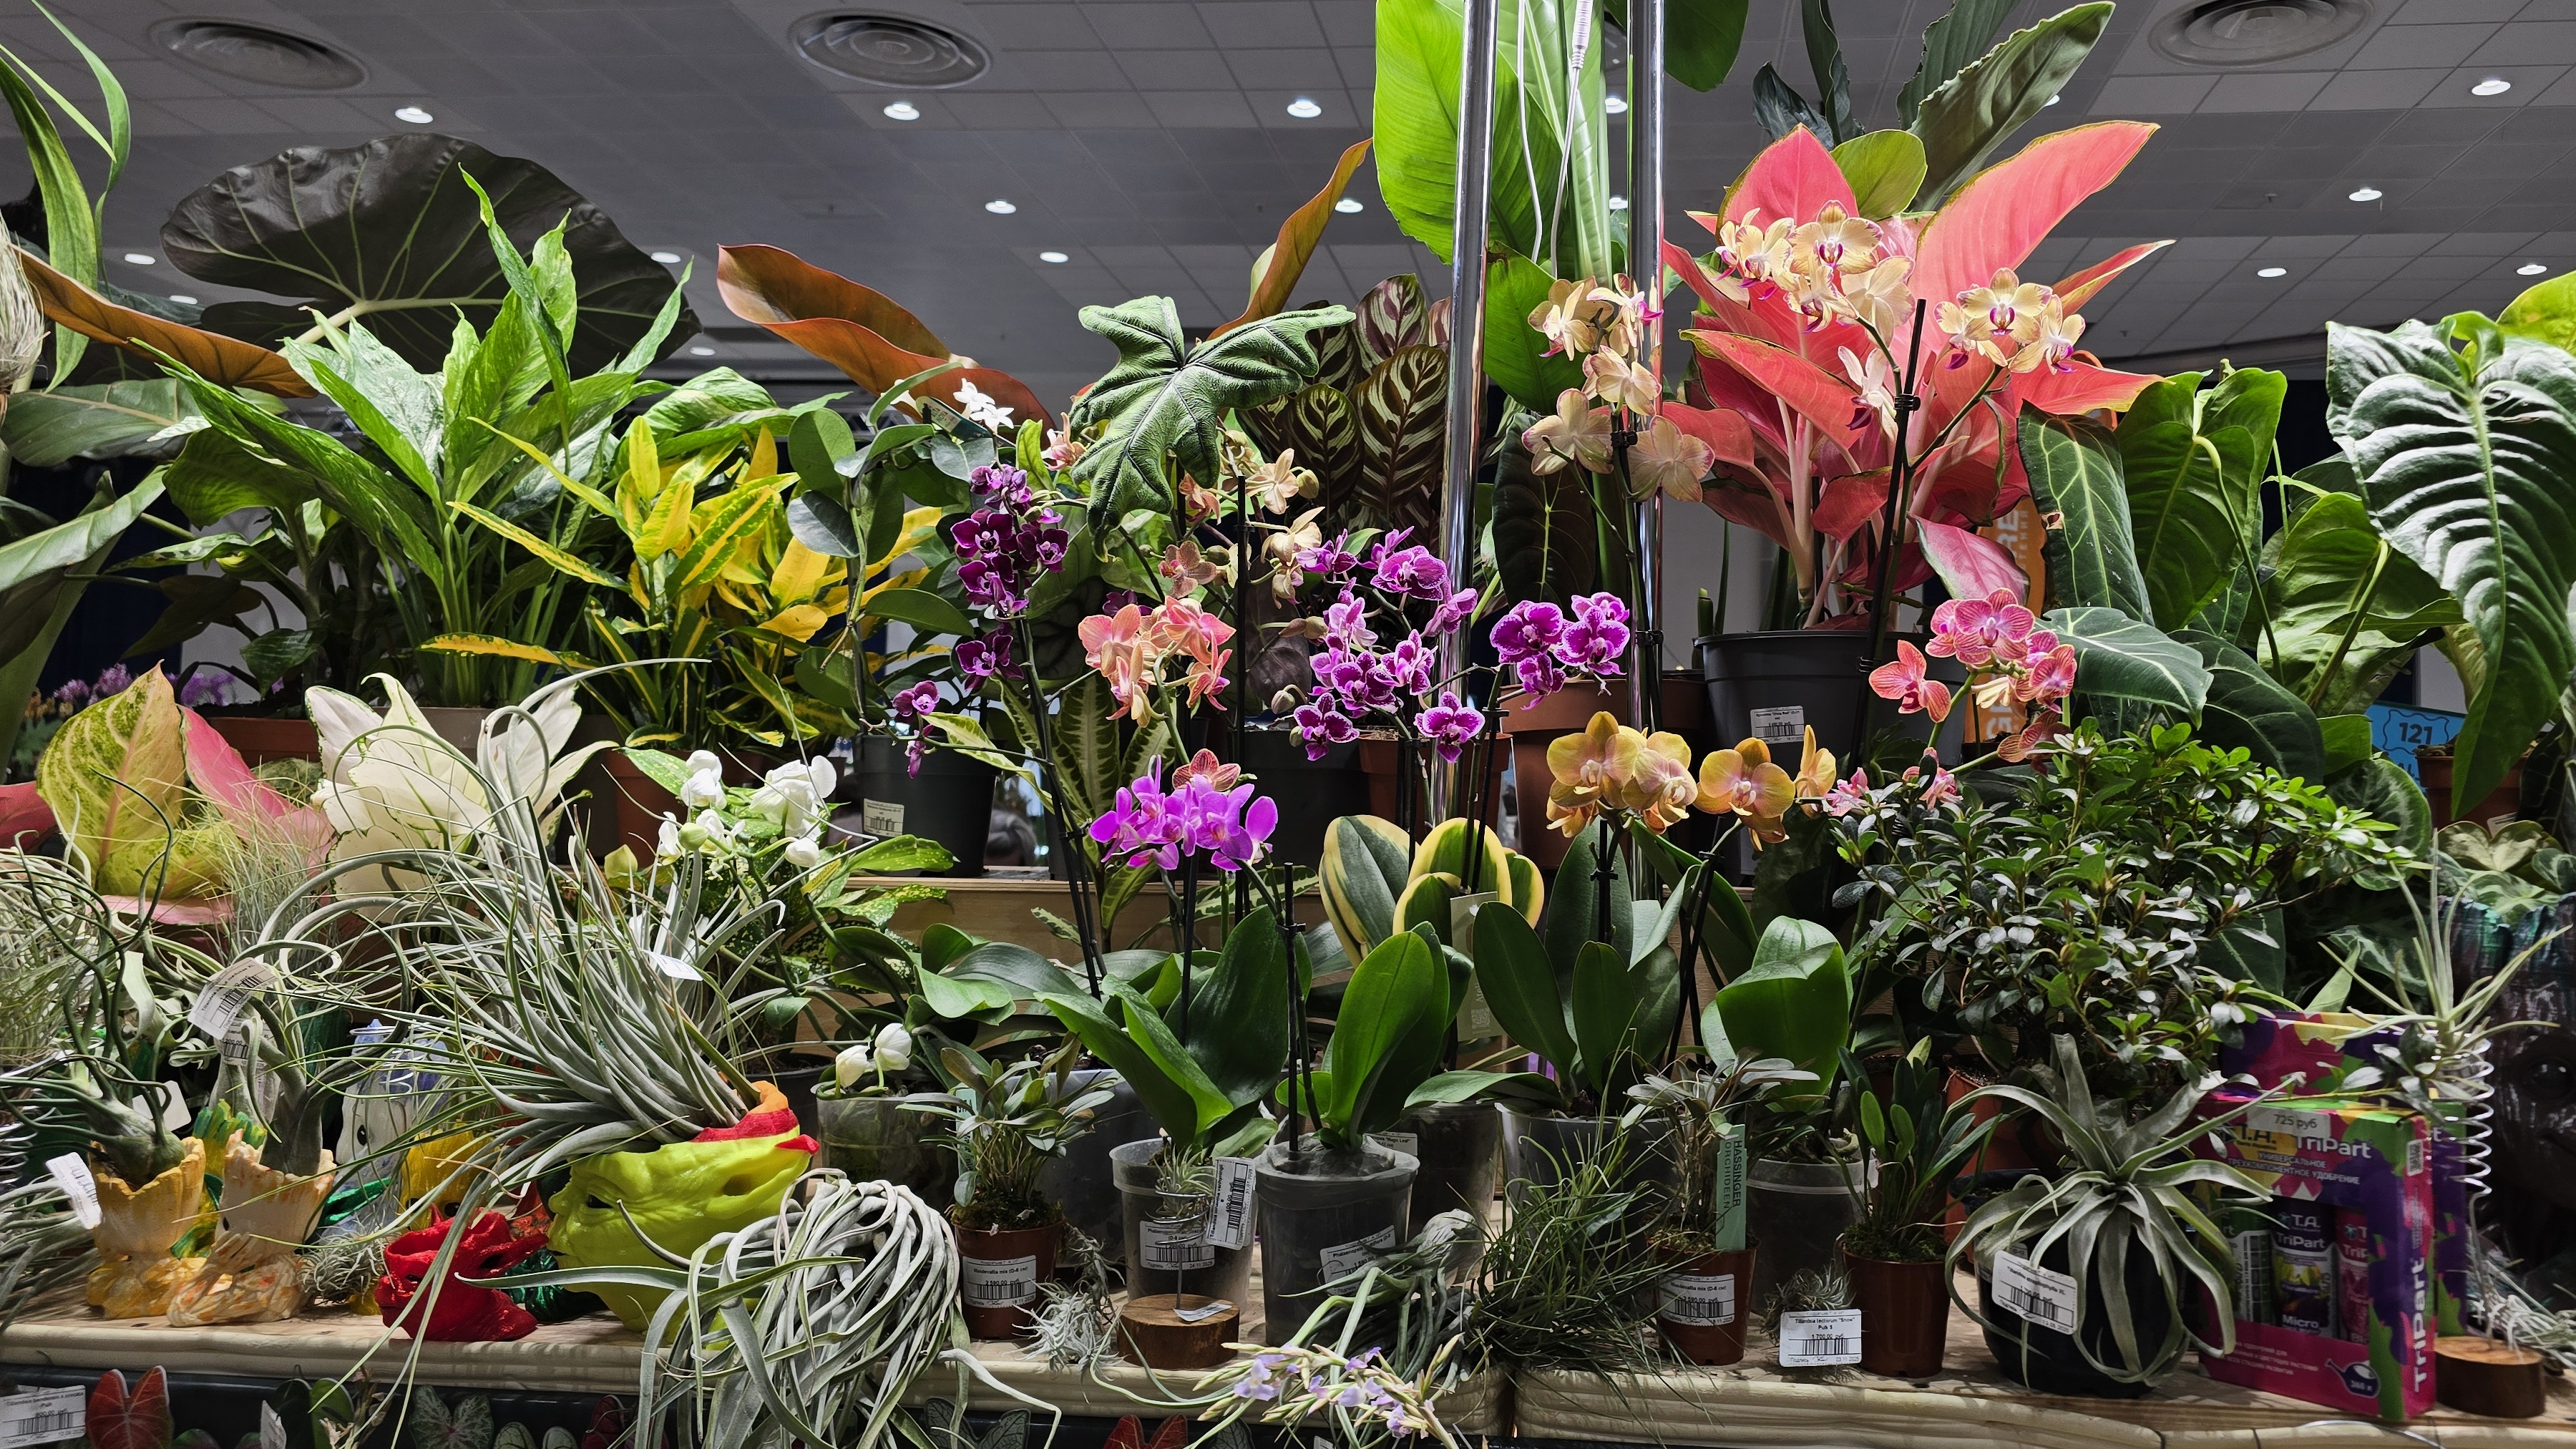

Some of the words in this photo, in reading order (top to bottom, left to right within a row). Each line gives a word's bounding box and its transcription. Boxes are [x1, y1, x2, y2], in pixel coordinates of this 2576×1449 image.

[2399, 722, 2432, 745] 121
[2274, 1114, 2294, 1126] 725
[2296, 1118, 2318, 1130] руб
[2296, 1136, 2372, 1158] TriPart
[1733, 1141, 1742, 1206] HASSINGER
[2276, 1232, 2326, 1249] TriPart
[2283, 1314, 2319, 1329] Micro
[2412, 1257, 2426, 1392] TriPart
